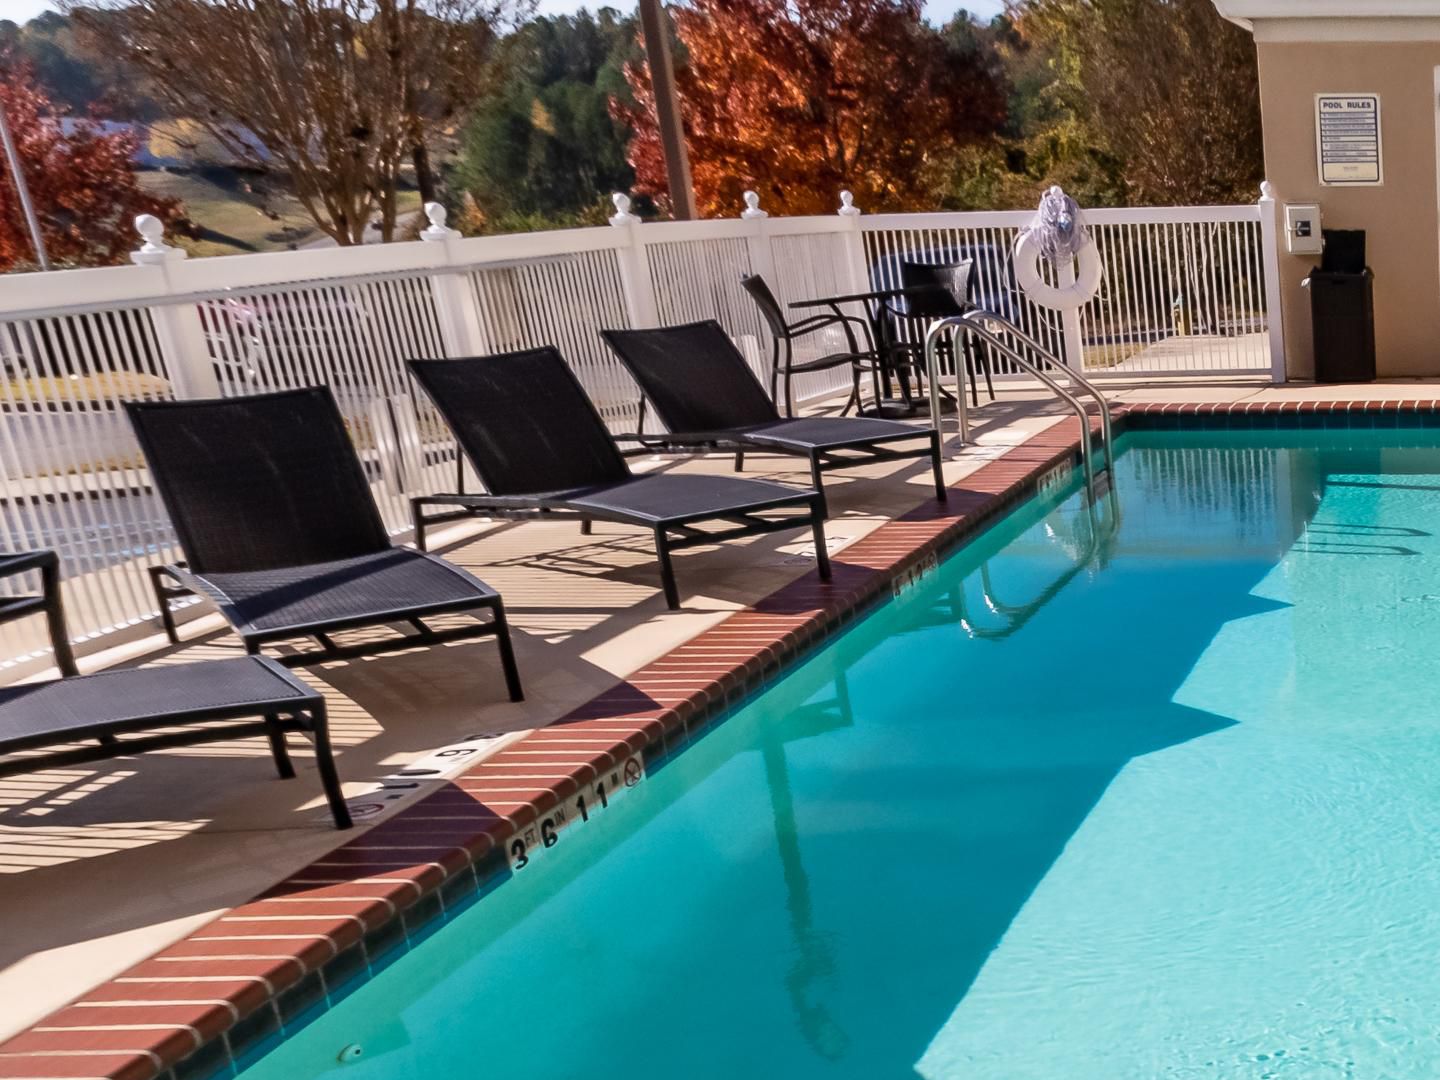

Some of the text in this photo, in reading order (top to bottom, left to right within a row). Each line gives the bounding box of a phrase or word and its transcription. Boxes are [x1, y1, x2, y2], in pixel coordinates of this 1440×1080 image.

[1322, 101, 1371, 109] POOL RULES
[511, 838, 529, 870] 3
[541, 817, 559, 849] 6
